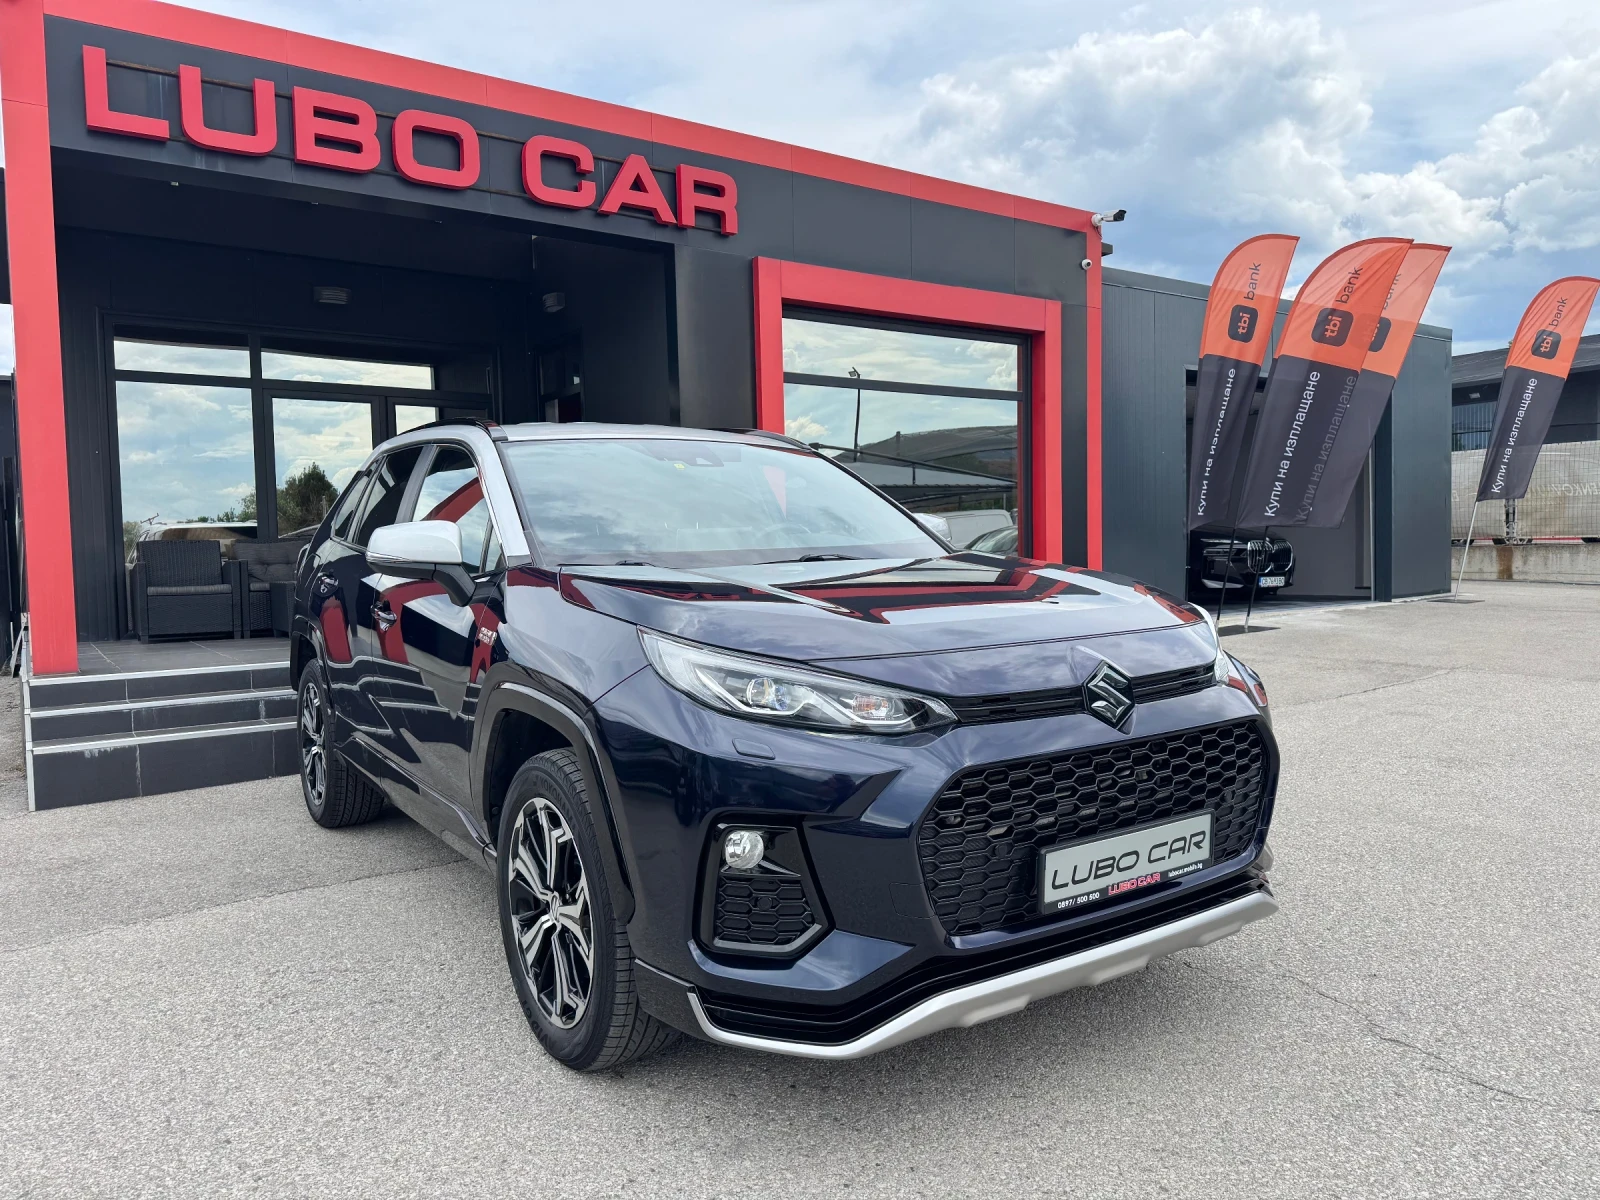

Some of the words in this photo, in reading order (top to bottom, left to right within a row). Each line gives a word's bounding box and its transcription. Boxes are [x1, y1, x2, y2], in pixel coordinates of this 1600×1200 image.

[82, 44, 480, 190] LUBO
[521, 135, 739, 236] CAR
[1243, 262, 1262, 300] bank
[1324, 315, 1343, 338] tbi
[1336, 266, 1363, 304] bank
[1237, 312, 1251, 335] tbi
[1540, 335, 1553, 353] tbi
[1549, 296, 1568, 327] bank
[1507, 378, 1538, 446] изплащане
[1197, 480, 1209, 516] Купи
[1204, 458, 1213, 476] на
[1209, 368, 1236, 455] изплащане
[1264, 481, 1284, 517] Купи
[1277, 460, 1291, 479] на
[1284, 371, 1321, 457] изплащане
[1502, 448, 1513, 463] на
[1310, 462, 1325, 482] на
[1491, 465, 1507, 493] Купи
[1051, 850, 1140, 890] LUBO
[1147, 830, 1207, 864] CAR
[1057, 897, 1076, 909] 0897/
[1077, 894, 1088, 904] 500
[1089, 891, 1100, 901] 500
[1107, 879, 1138, 896] LUBO
[1138, 872, 1161, 887] CAR
